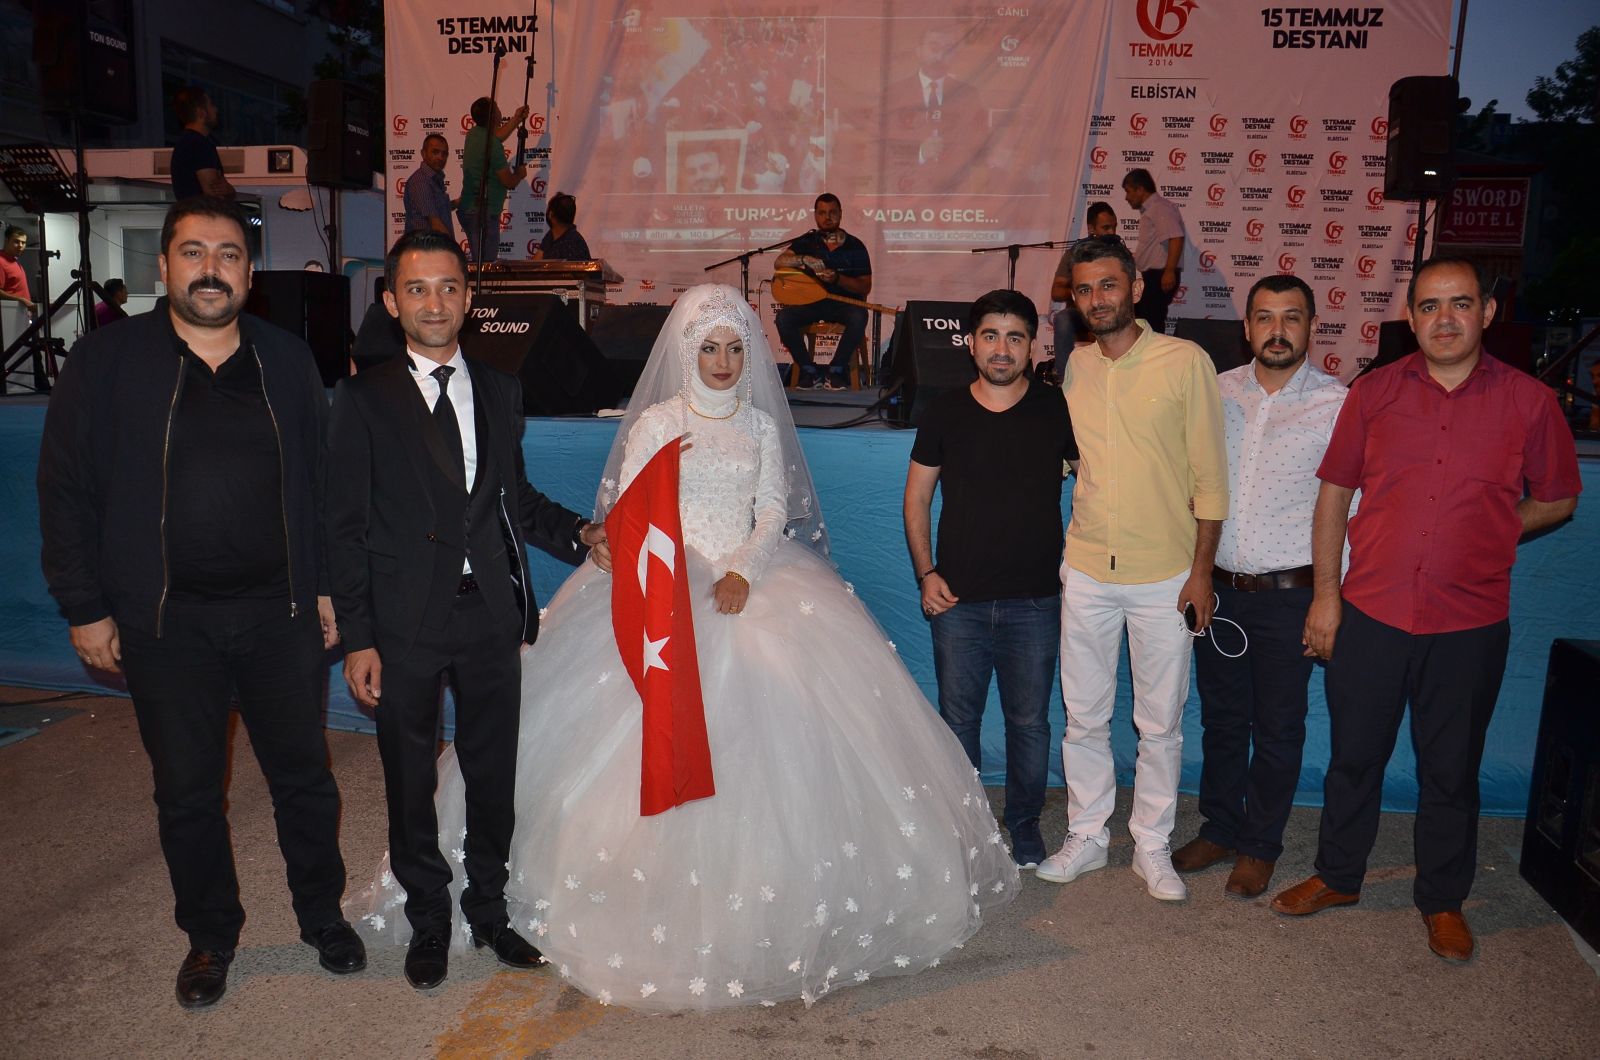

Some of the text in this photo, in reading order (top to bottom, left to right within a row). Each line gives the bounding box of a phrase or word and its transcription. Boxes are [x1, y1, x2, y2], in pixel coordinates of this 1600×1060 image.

[437, 15, 538, 35] 15 TEMMUZ
[1261, 8, 1383, 27] 15 TEMMUZ
[89, 31, 127, 51] TON SOUND
[448, 36, 527, 54] DESTANI
[1273, 30, 1368, 49] DESTANI
[1129, 43, 1193, 58] TEMMUZ
[1131, 83, 1196, 99] ELBİSTAN
[1452, 186, 1521, 208] SWORD
[921, 209, 934, 222] O
[1453, 211, 1515, 226] HOTEL
[471, 308, 499, 318] TON
[480, 322, 530, 334] SOUND
[922, 318, 960, 330] TON
